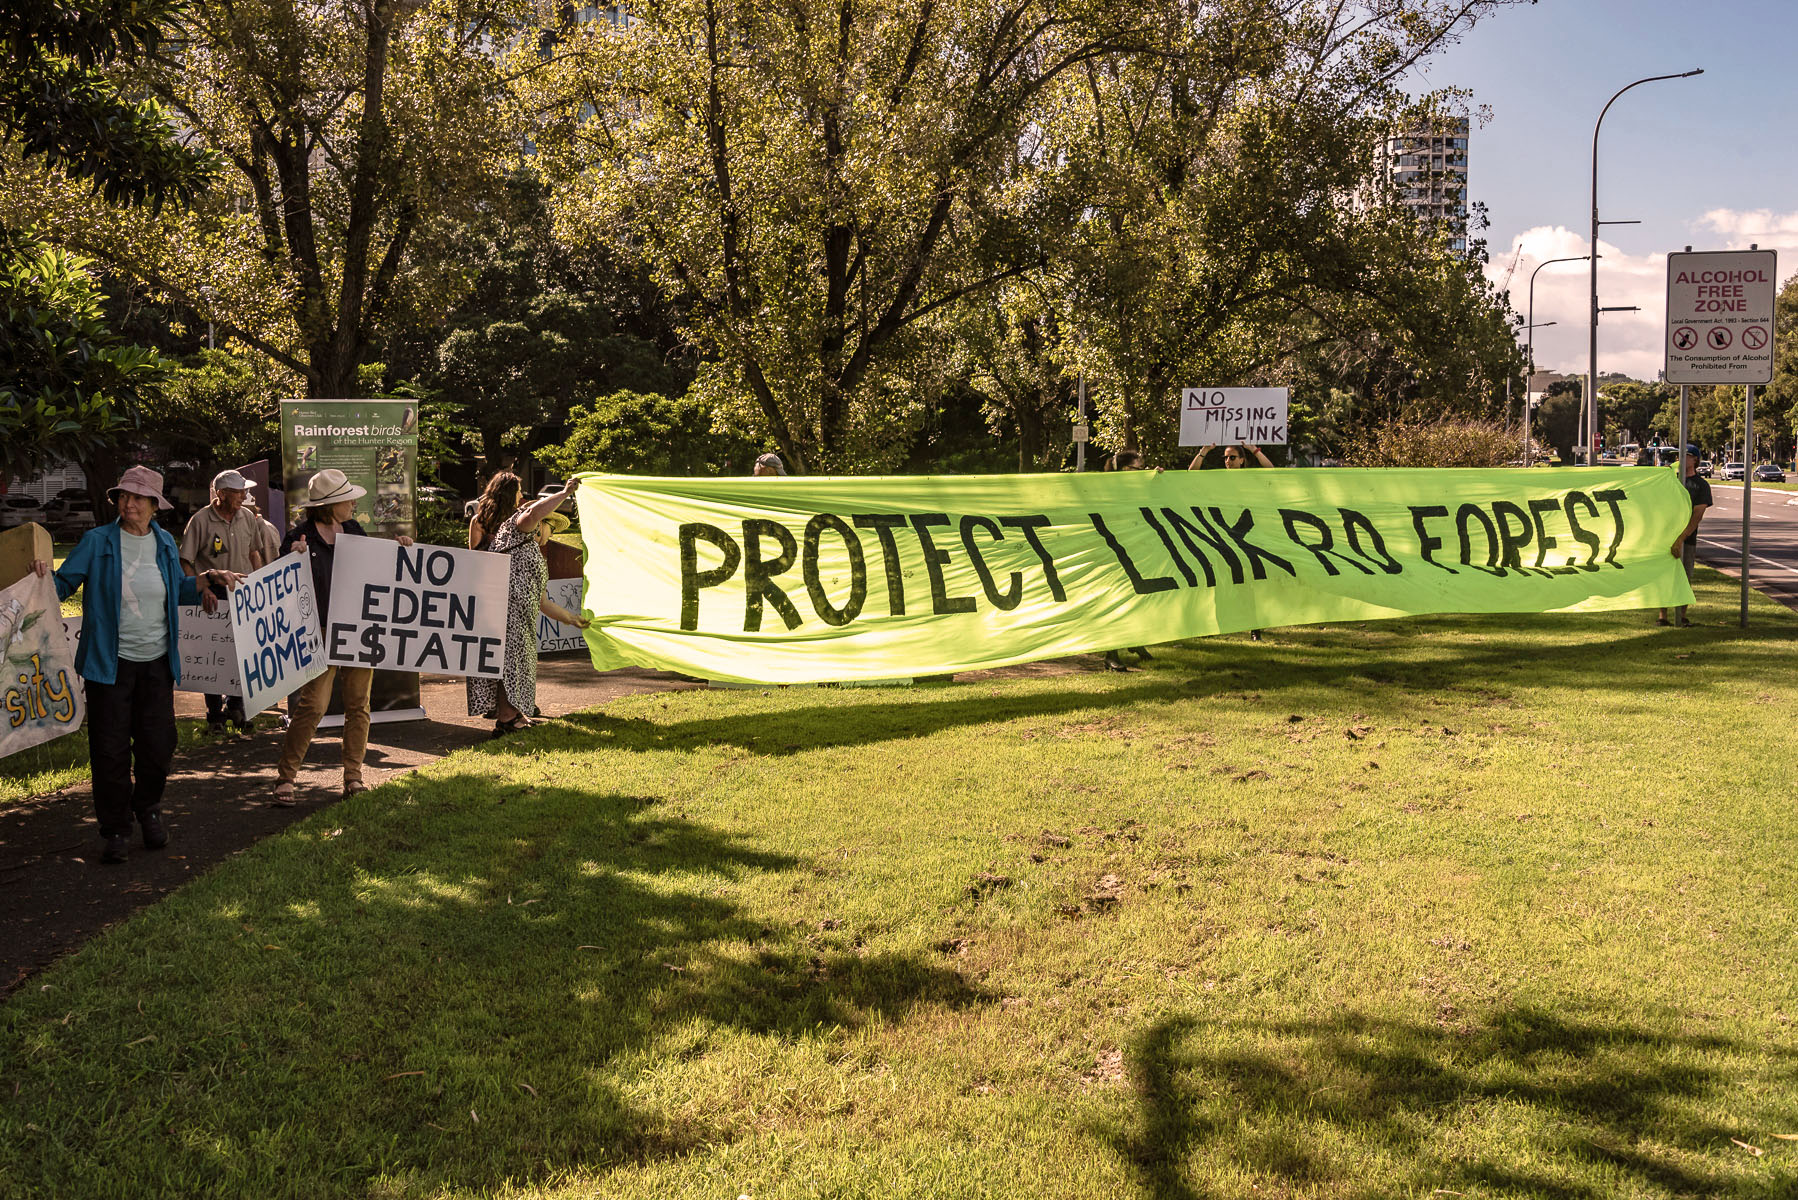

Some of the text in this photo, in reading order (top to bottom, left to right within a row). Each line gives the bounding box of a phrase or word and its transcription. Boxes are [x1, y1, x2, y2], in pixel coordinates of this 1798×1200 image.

[1675, 270, 1769, 285] ALCOHOL
[1697, 285, 1744, 298] FREE
[1694, 299, 1747, 313] ZONE
[1684, 354, 1731, 363] Consumption
[1188, 391, 1225, 407] NO
[1206, 406, 1277, 422] MISSING
[294, 424, 402, 437] Rainforest birds
[1235, 425, 1284, 442] LINK
[333, 436, 413, 446] of the Hunter Region
[395, 546, 455, 586] NO
[679, 488, 1628, 632] PROTECT LINK RD FOREST
[234, 562, 302, 626] PROTECT
[361, 583, 476, 631] EDEN
[255, 606, 291, 647] OUR
[329, 622, 502, 674] E$TATE
[541, 636, 588, 651] ESTATE
[184, 651, 226, 666] exile
[244, 626, 312, 699] HOME
[6, 652, 76, 729] sity
